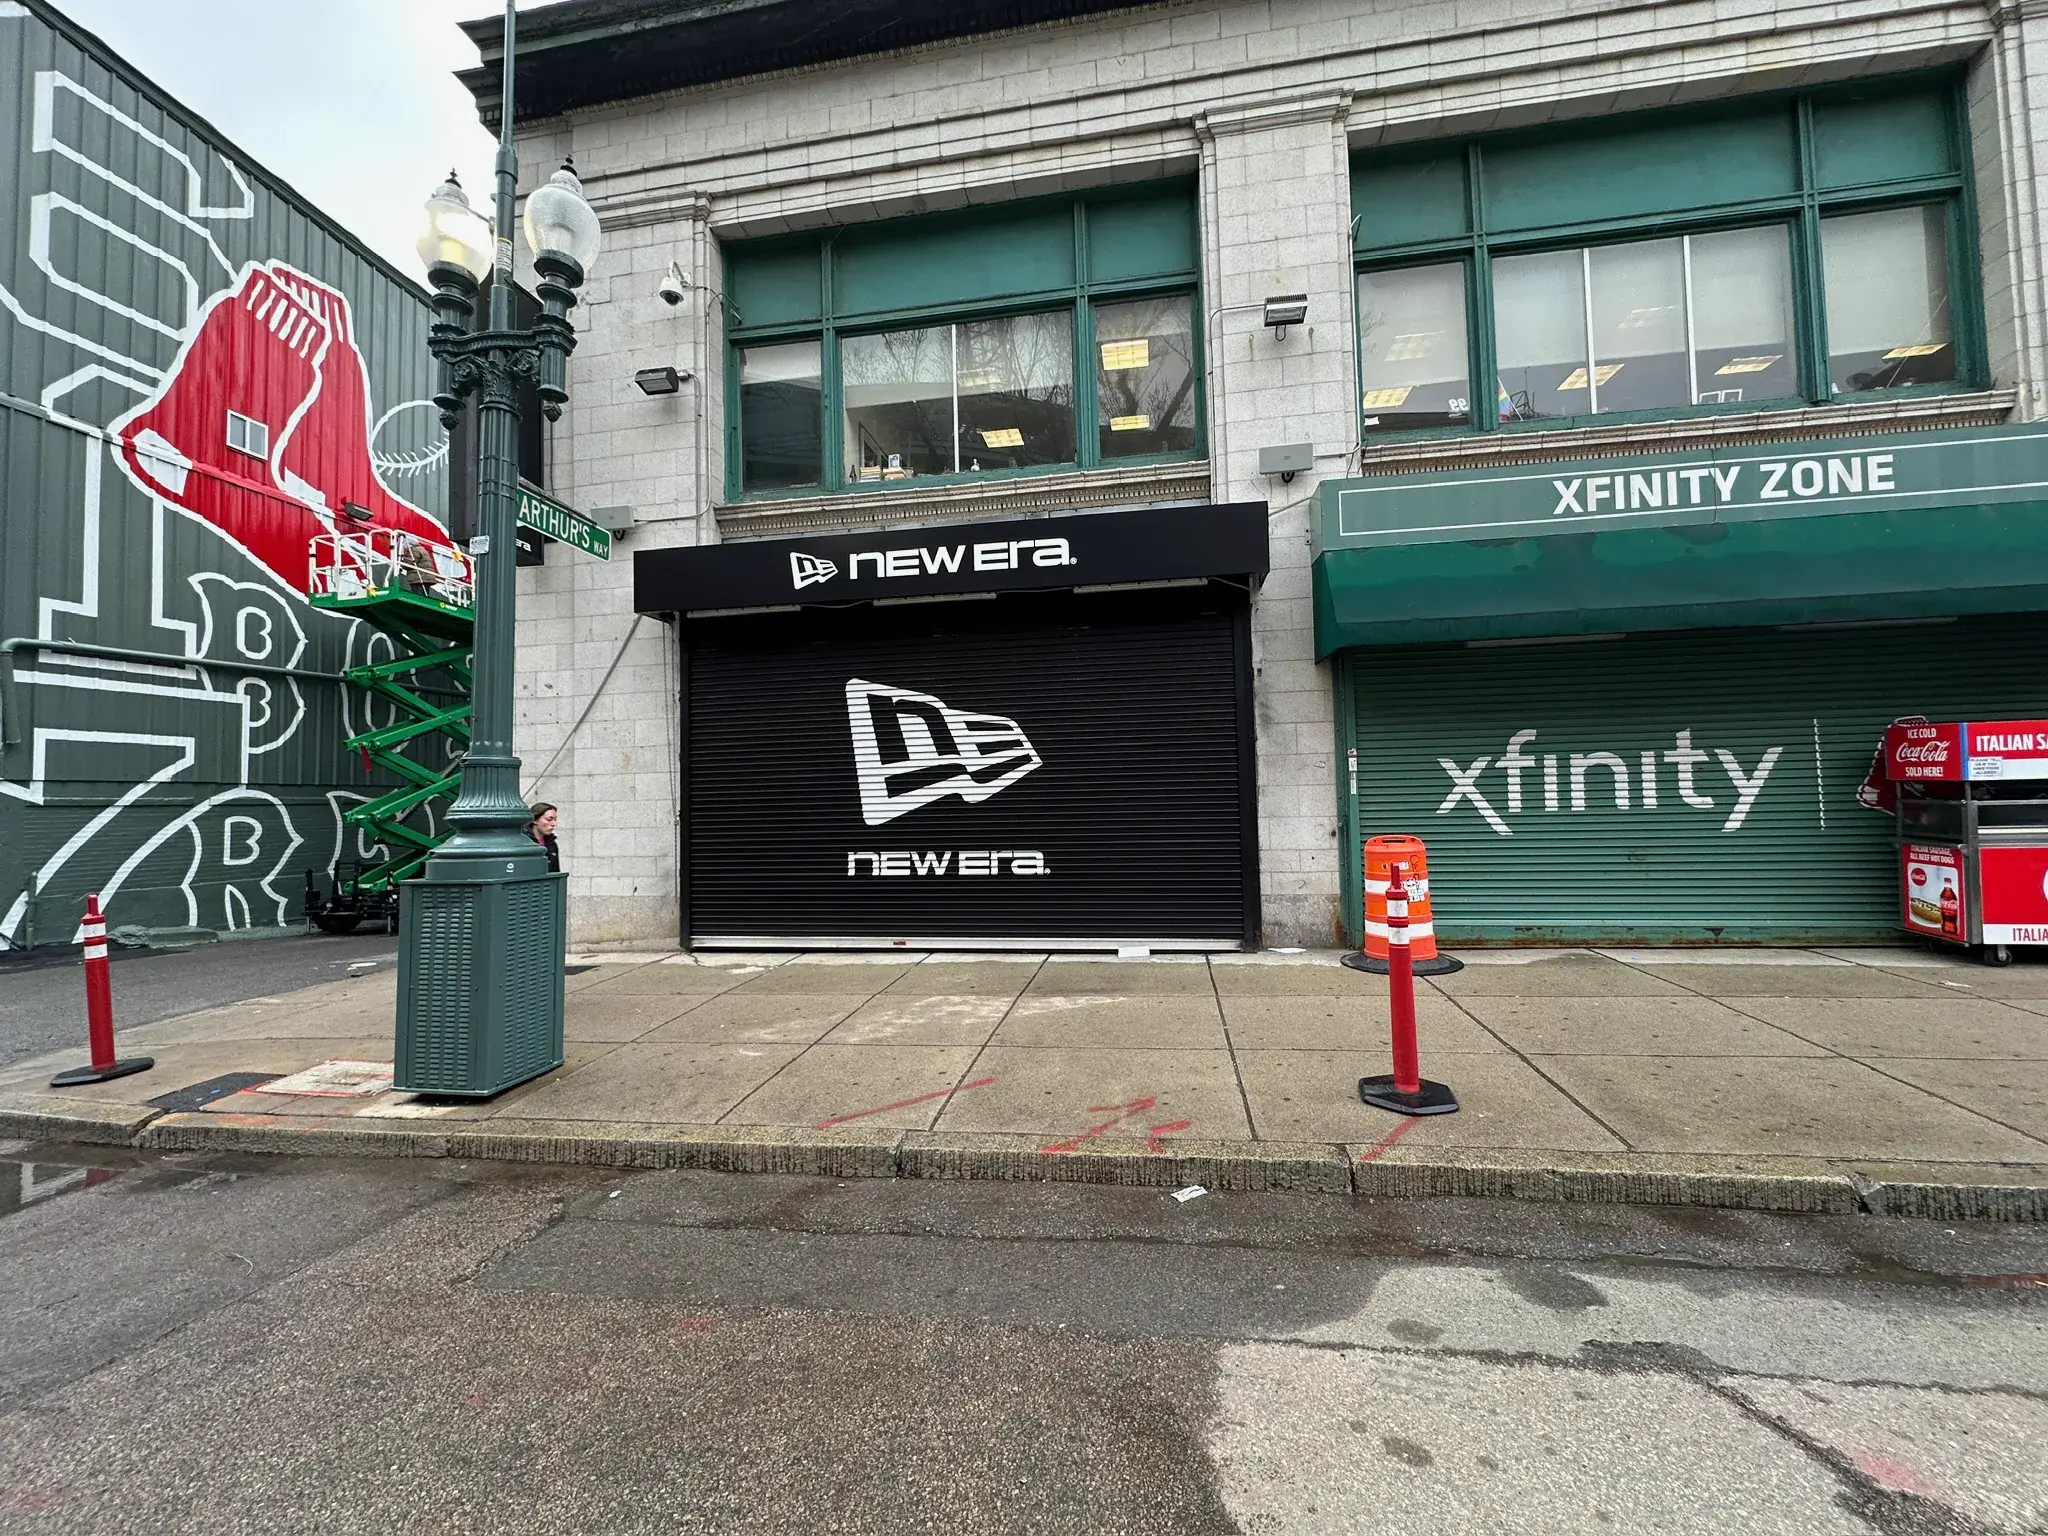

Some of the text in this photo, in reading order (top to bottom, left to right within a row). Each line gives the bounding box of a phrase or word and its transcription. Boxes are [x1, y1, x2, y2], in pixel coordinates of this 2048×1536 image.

[1552, 454, 1896, 515] XFINITY ZONE
[519, 495, 590, 549] ARTHUR'S
[593, 540, 609, 557] WAY
[1907, 728, 1937, 739] ICE COLD
[1976, 733, 2048, 752] ITALIAN S
[1436, 728, 1783, 835] xfinity
[1905, 767, 1922, 778] SOLD
